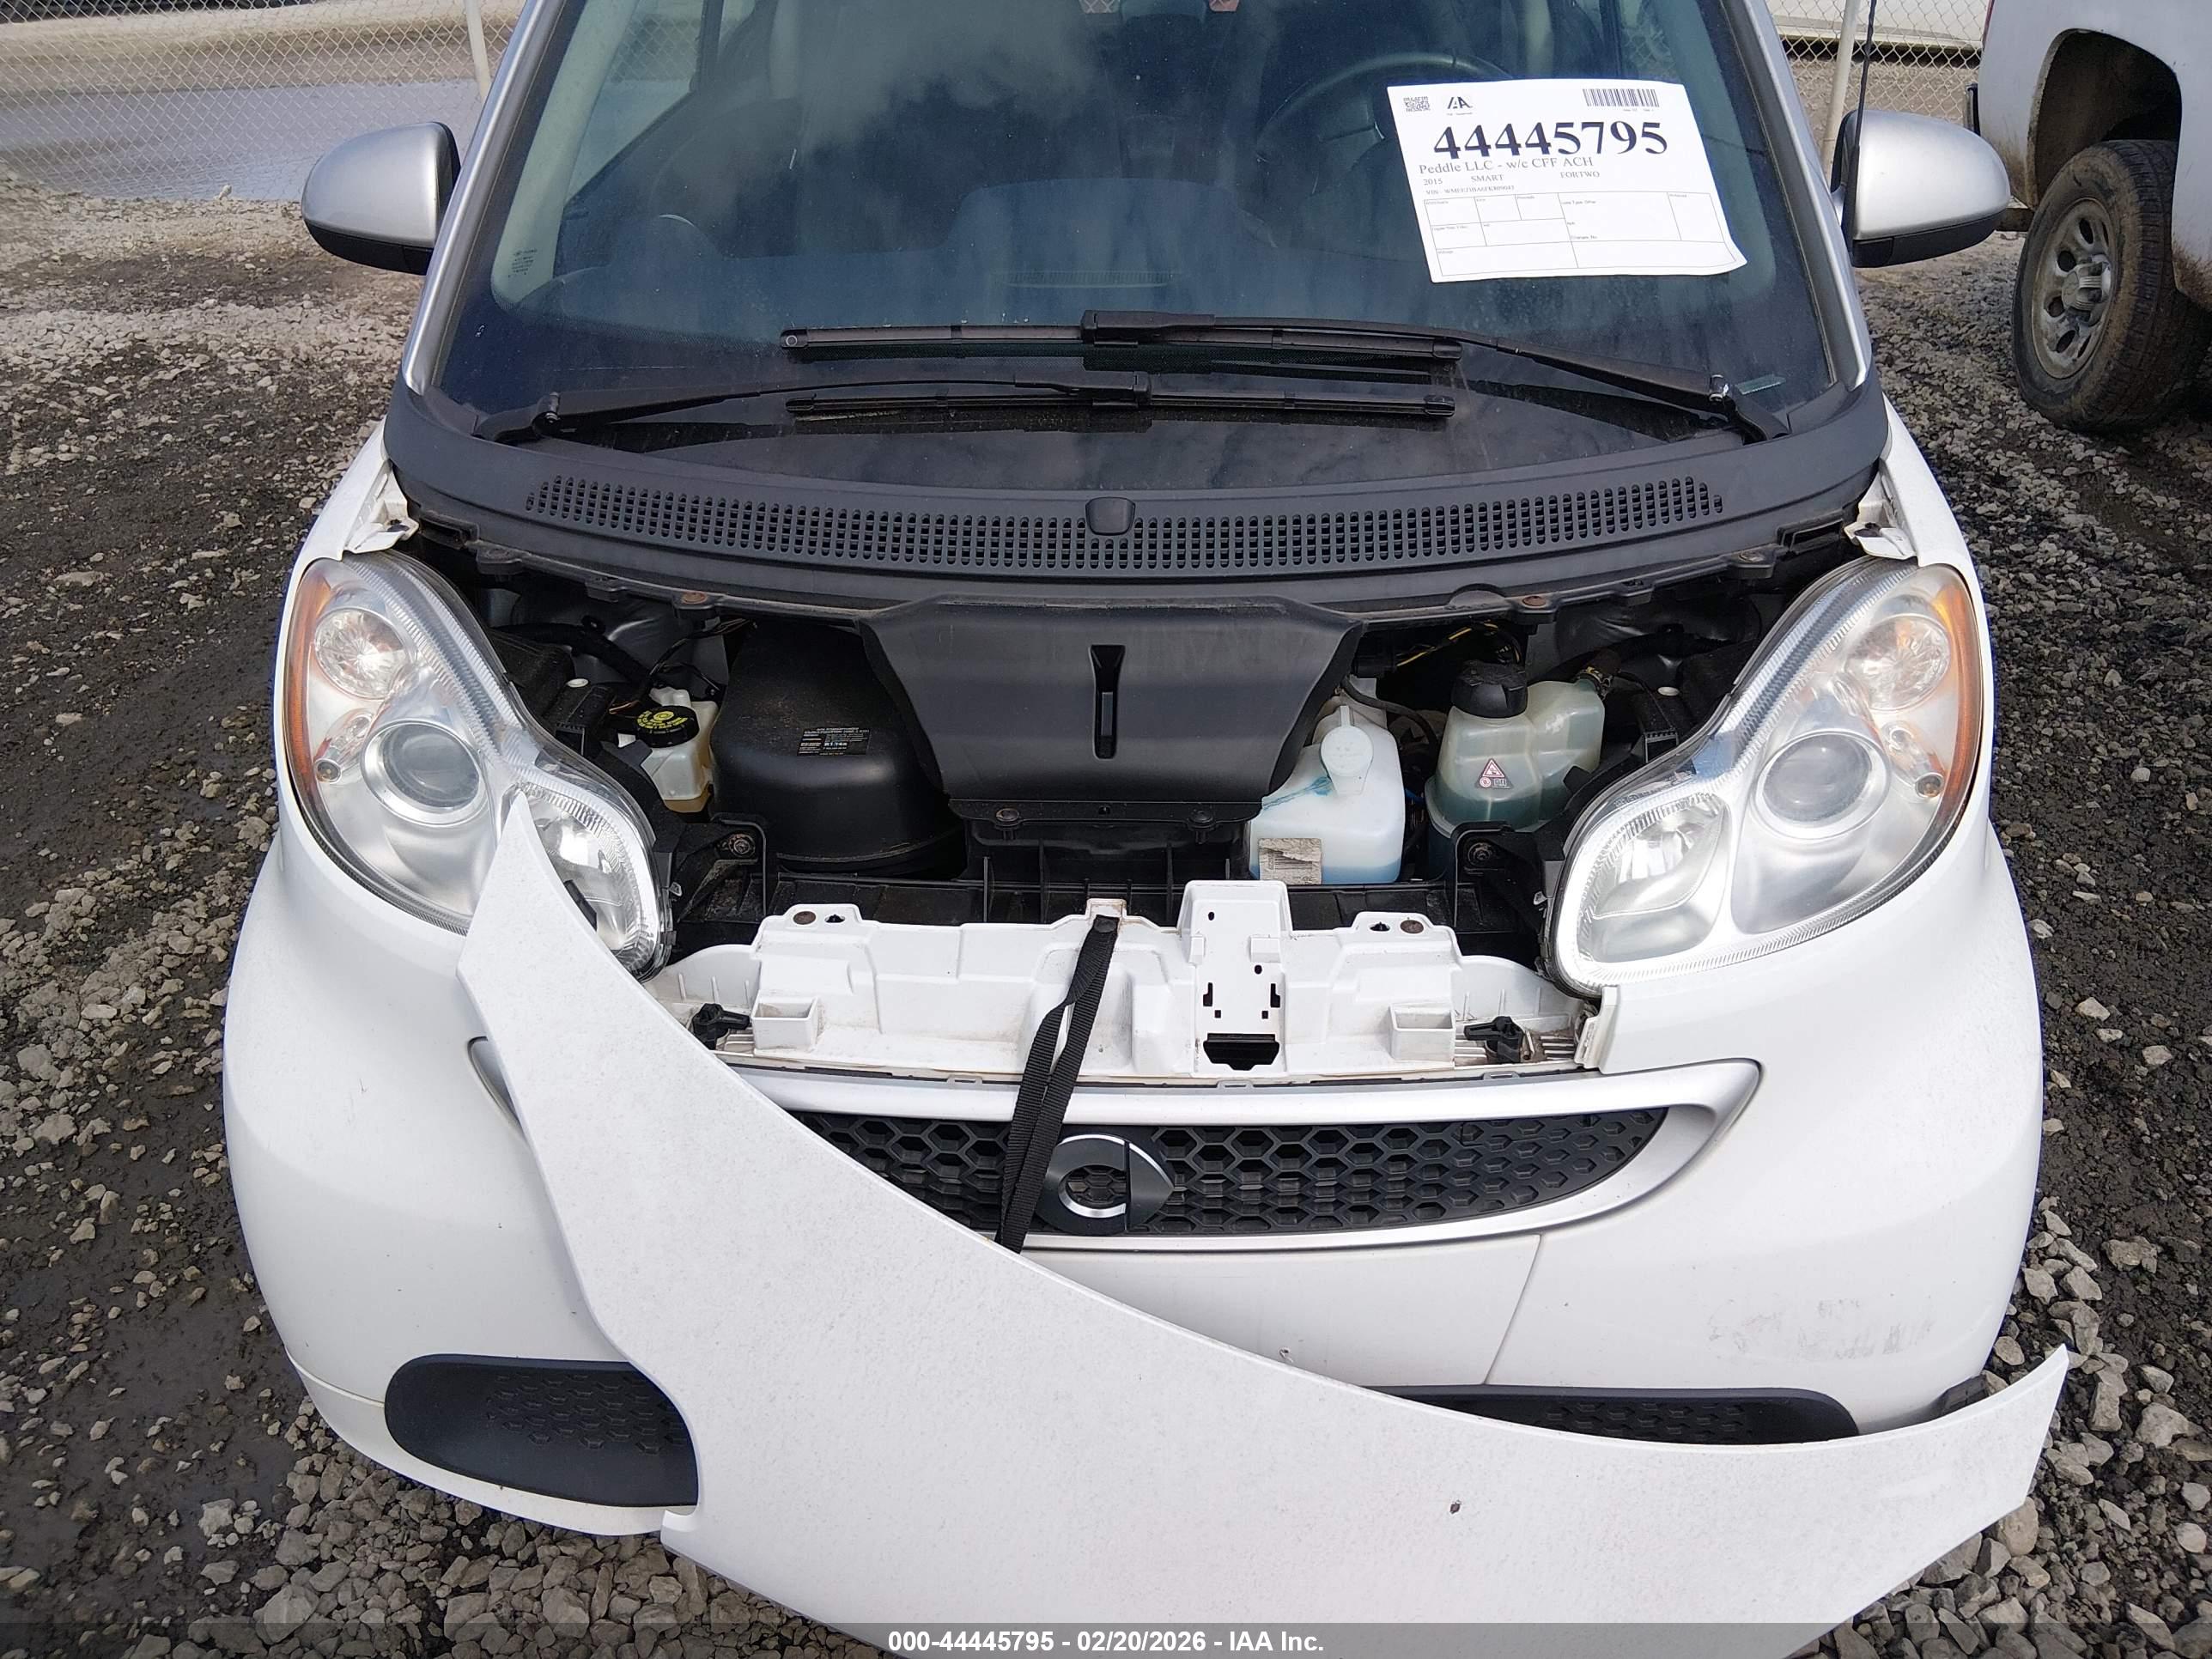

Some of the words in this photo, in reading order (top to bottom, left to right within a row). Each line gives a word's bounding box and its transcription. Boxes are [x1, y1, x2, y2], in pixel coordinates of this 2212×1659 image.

[1435, 122, 1667, 158] 44445795
[1419, 163, 1462, 174] Peddle
[1466, 160, 1493, 171] LLC
[1505, 158, 1528, 168] w/c
[1532, 157, 1558, 168] CFF
[1563, 155, 1594, 167] ACH
[1470, 173, 1504, 182] SMART
